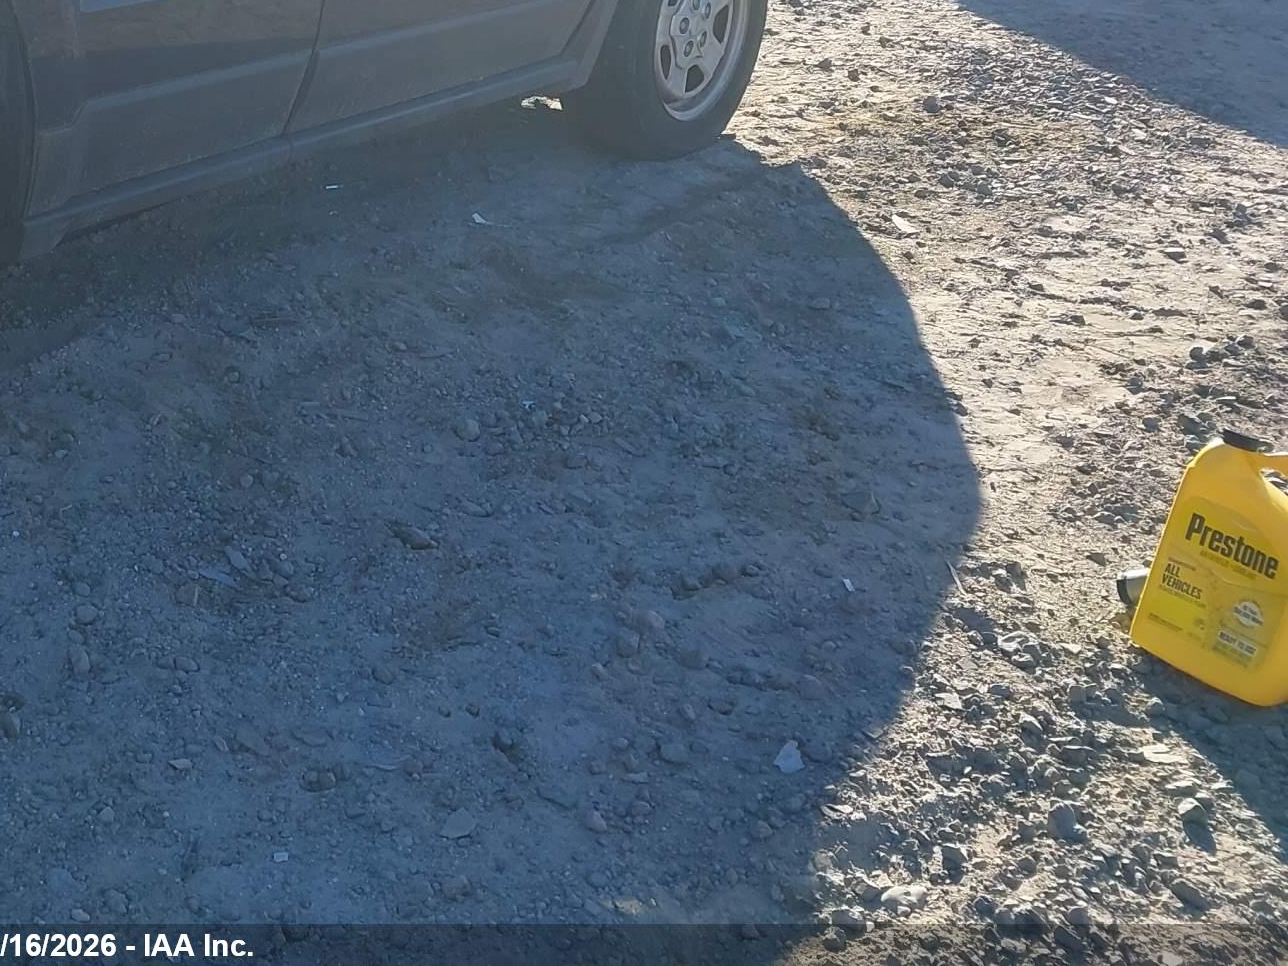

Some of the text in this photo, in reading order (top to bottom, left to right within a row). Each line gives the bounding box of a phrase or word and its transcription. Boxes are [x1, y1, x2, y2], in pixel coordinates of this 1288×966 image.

[1185, 513, 1279, 579] Prestone
[1164, 562, 1183, 579] ALL
[1161, 574, 1202, 600] VEHICLES
